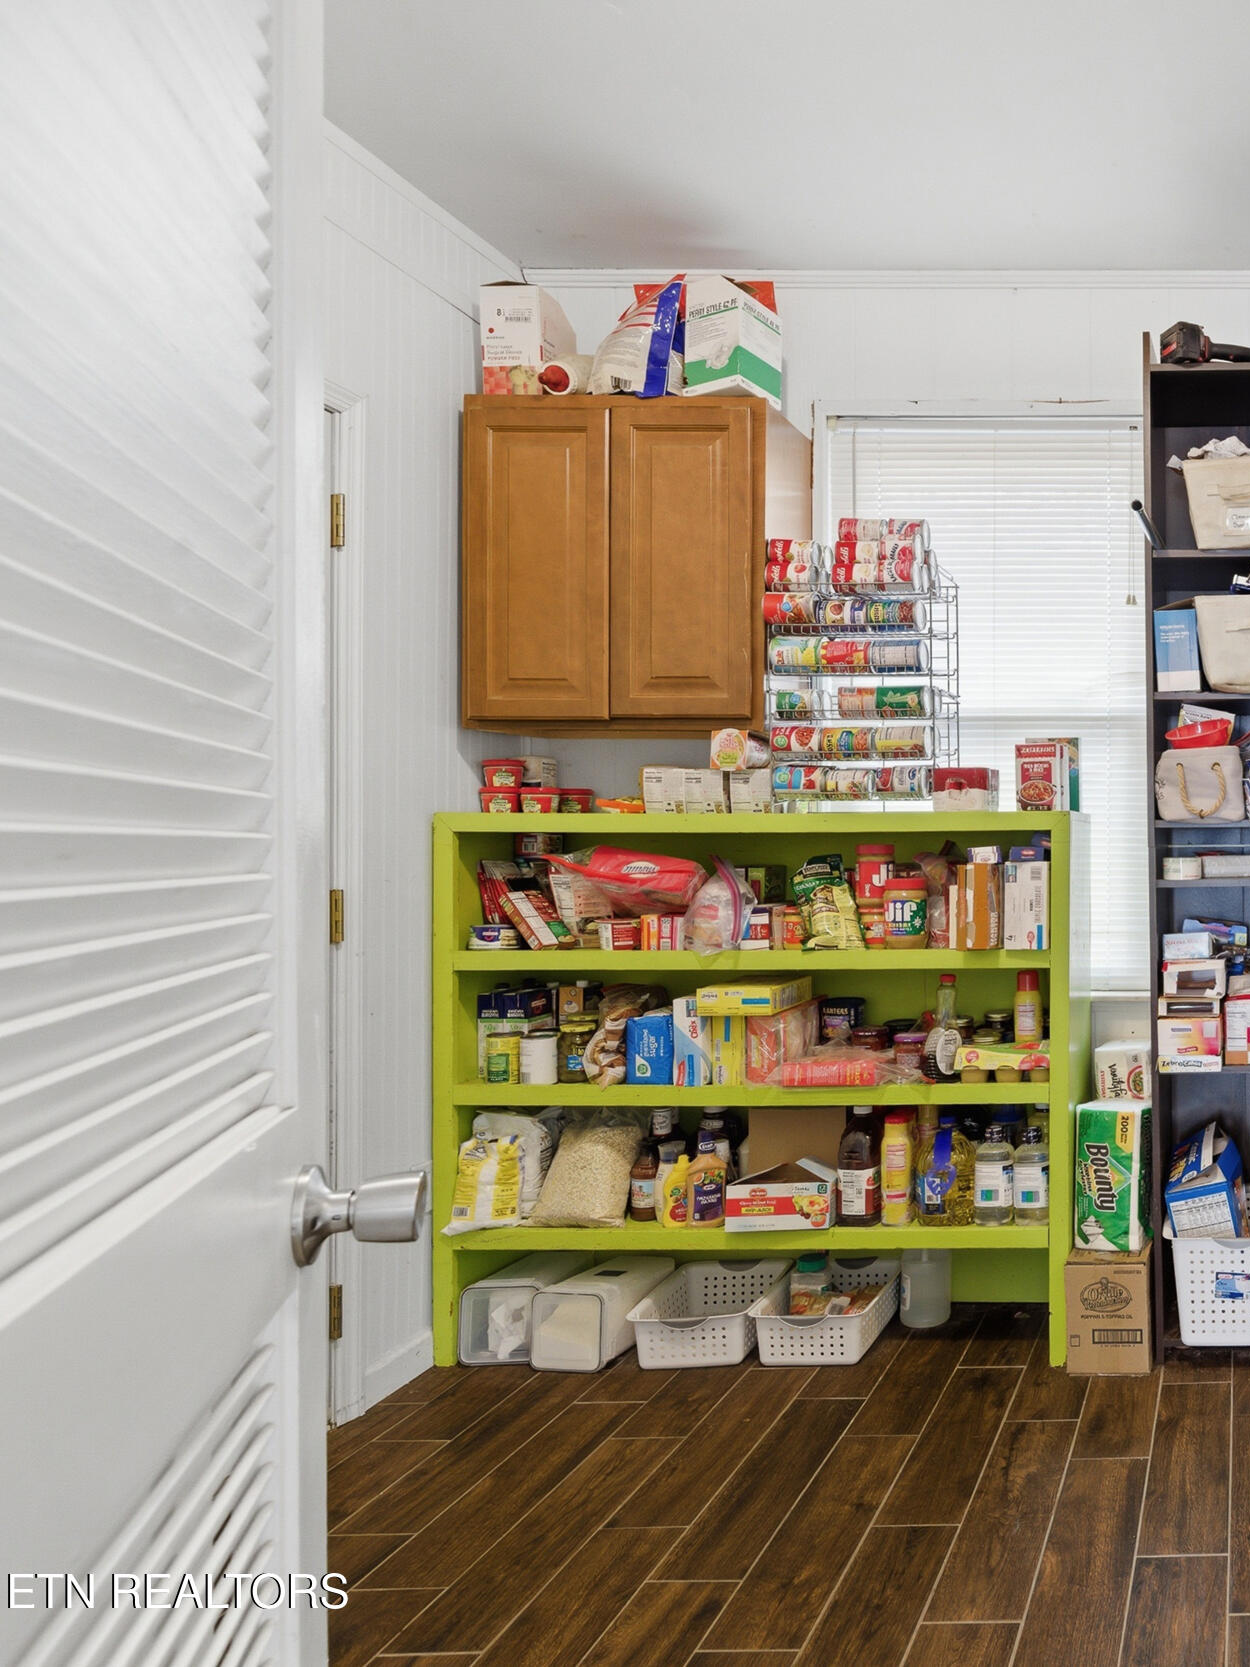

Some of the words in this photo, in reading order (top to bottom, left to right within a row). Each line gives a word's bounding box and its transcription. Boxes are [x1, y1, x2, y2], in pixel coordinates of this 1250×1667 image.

[705, 302, 722, 314] STYLE
[871, 863, 894, 887] Ji
[884, 902, 917, 922] Jif
[649, 1035, 658, 1057] sugar
[1120, 1115, 1130, 1134] 200
[1084, 1142, 1118, 1212] Bounty
